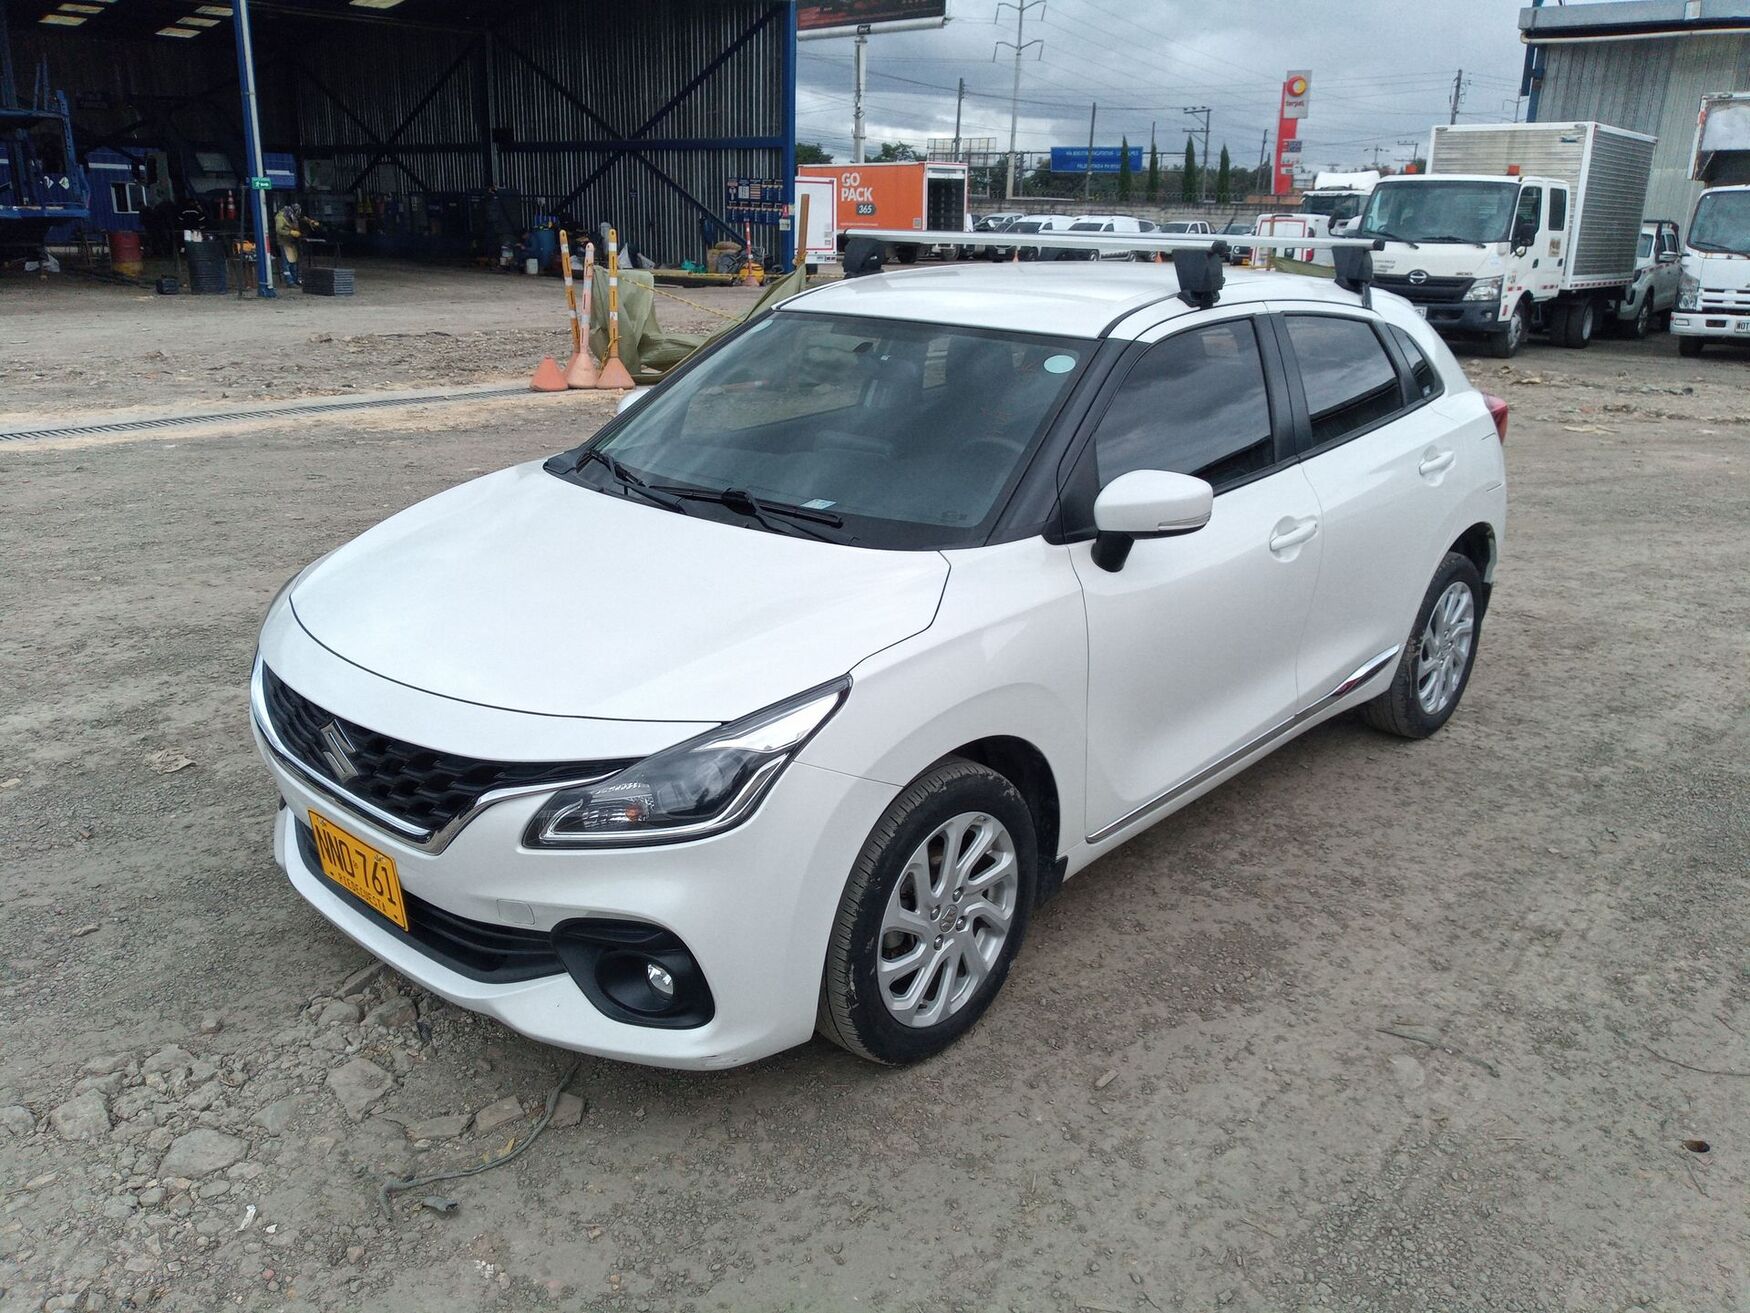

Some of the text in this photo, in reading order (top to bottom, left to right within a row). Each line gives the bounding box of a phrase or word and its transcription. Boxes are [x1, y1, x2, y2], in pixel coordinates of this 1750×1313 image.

[841, 172, 860, 187] GO
[841, 187, 873, 202] PACK
[858, 204, 873, 214] 365
[354, 848, 397, 906] 761
